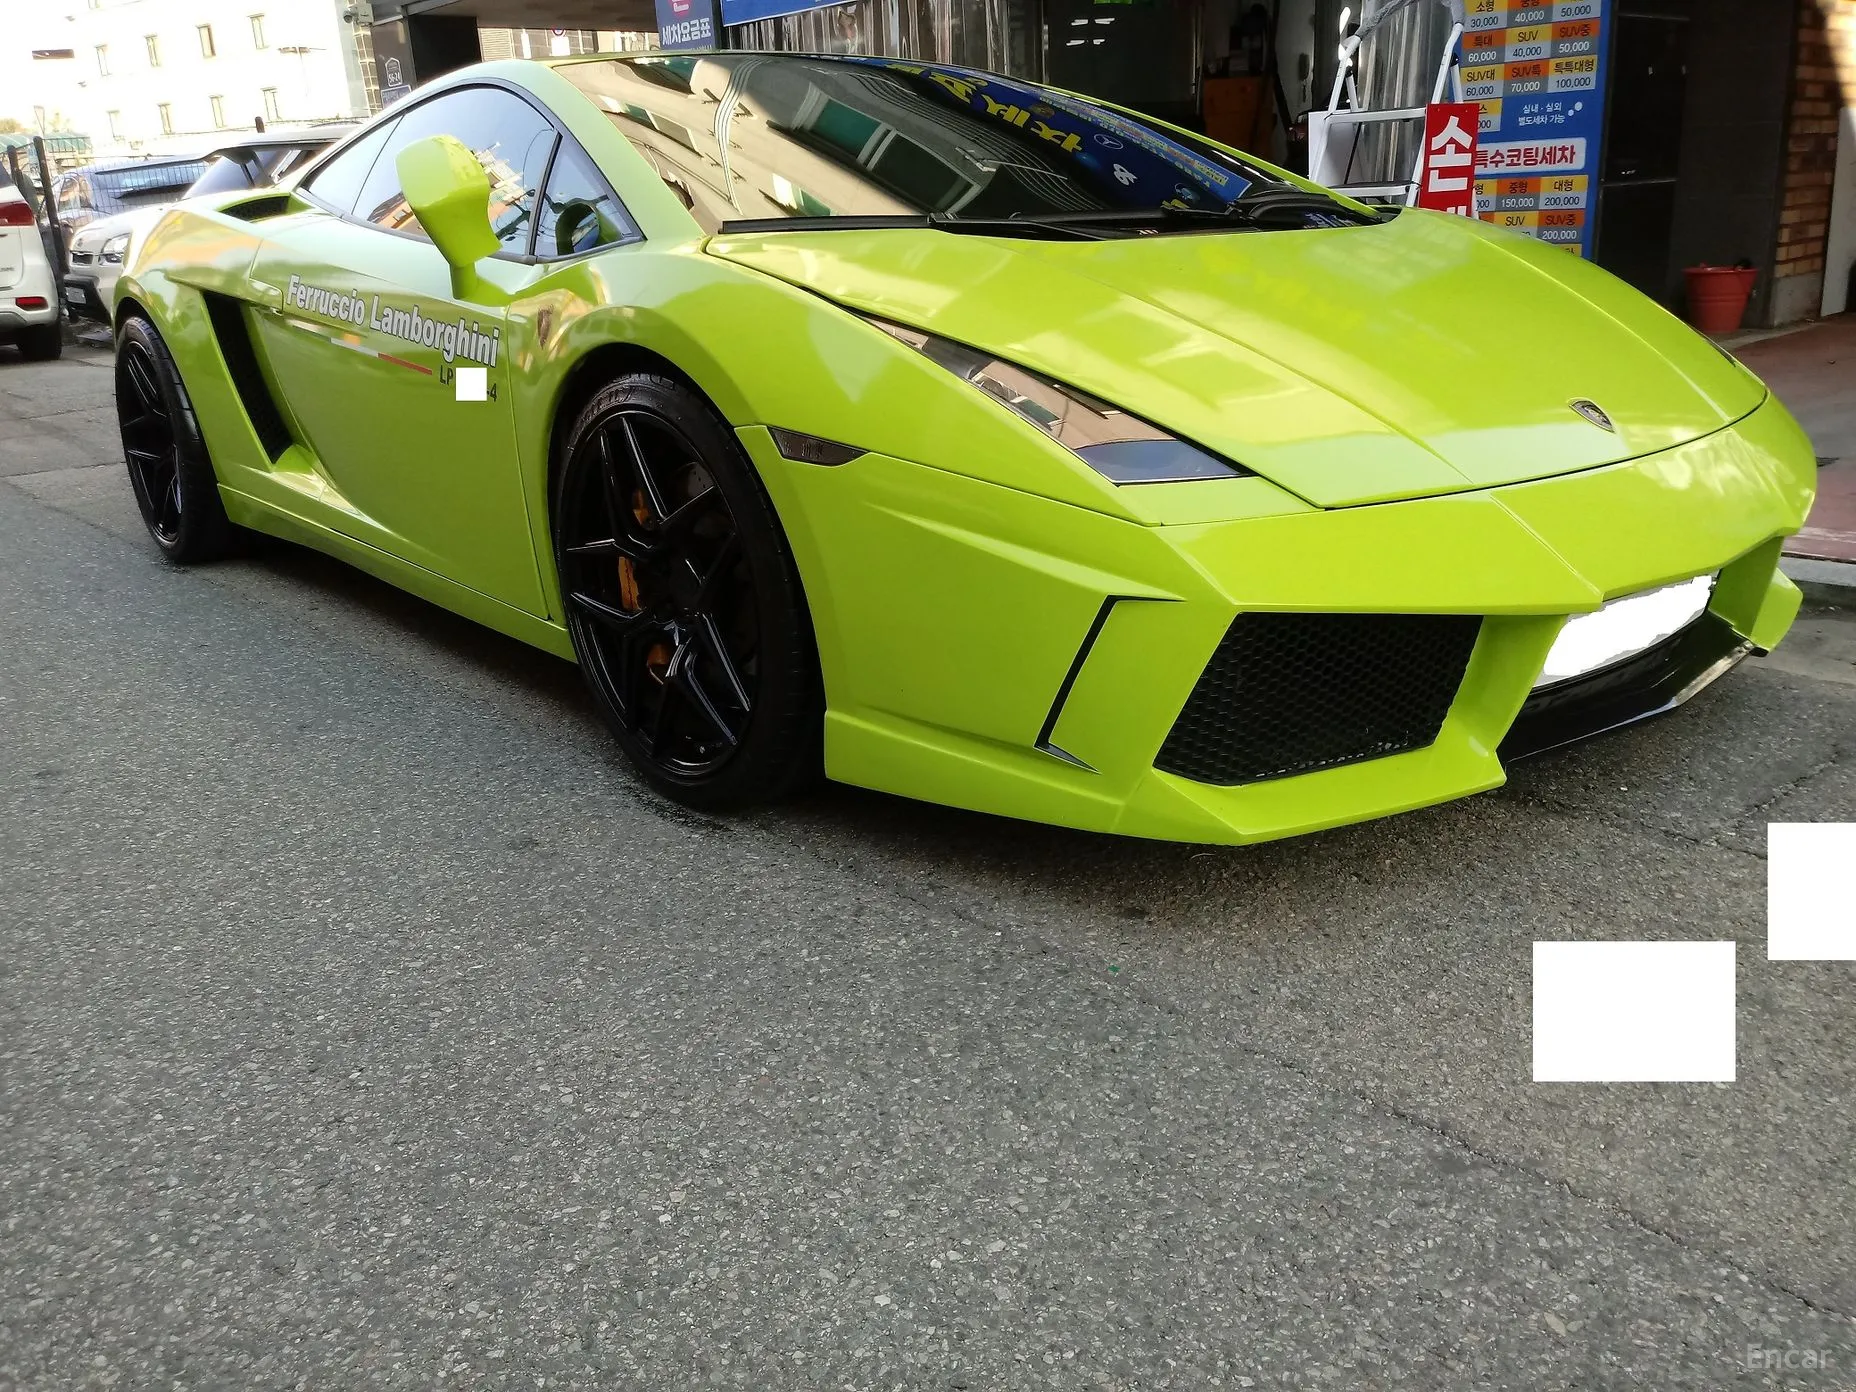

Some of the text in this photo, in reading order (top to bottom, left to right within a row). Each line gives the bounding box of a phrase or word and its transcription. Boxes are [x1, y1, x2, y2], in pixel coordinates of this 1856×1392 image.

[1476, 0, 1494, 12] 소형
[1560, 5, 1591, 17] 50,000
[1470, 16, 1499, 28] 30,000
[1515, 10, 1545, 23] 40,000
[662, 17, 711, 46] 세차요금표
[1518, 30, 1539, 42] SUV
[1559, 24, 1591, 38] SUV중
[1474, 34, 1493, 47] 특대
[1513, 46, 1542, 58] 40,000
[1559, 41, 1590, 53] 50,000
[1468, 51, 1496, 62] 60,000
[1511, 65, 1541, 78] SUV특
[1554, 59, 1594, 73] 특특대형
[1466, 69, 1496, 82] SUV대
[1511, 81, 1540, 93] 70,000
[1556, 77, 1591, 88] 100,000
[1466, 86, 1494, 97] 60,000
[1549, 114, 1566, 124] 가능
[1475, 144, 1576, 168] 특수코팅세차
[1428, 115, 1473, 216] 손
[1553, 179, 1574, 192] 대형
[1501, 198, 1534, 208] 150,000
[1544, 196, 1580, 207] 200,000
[1505, 216, 1526, 226] SUV
[1546, 213, 1576, 226] SUV중
[1542, 230, 1577, 240] 200,000
[285, 274, 500, 368] Ferruccio Lamborghini
